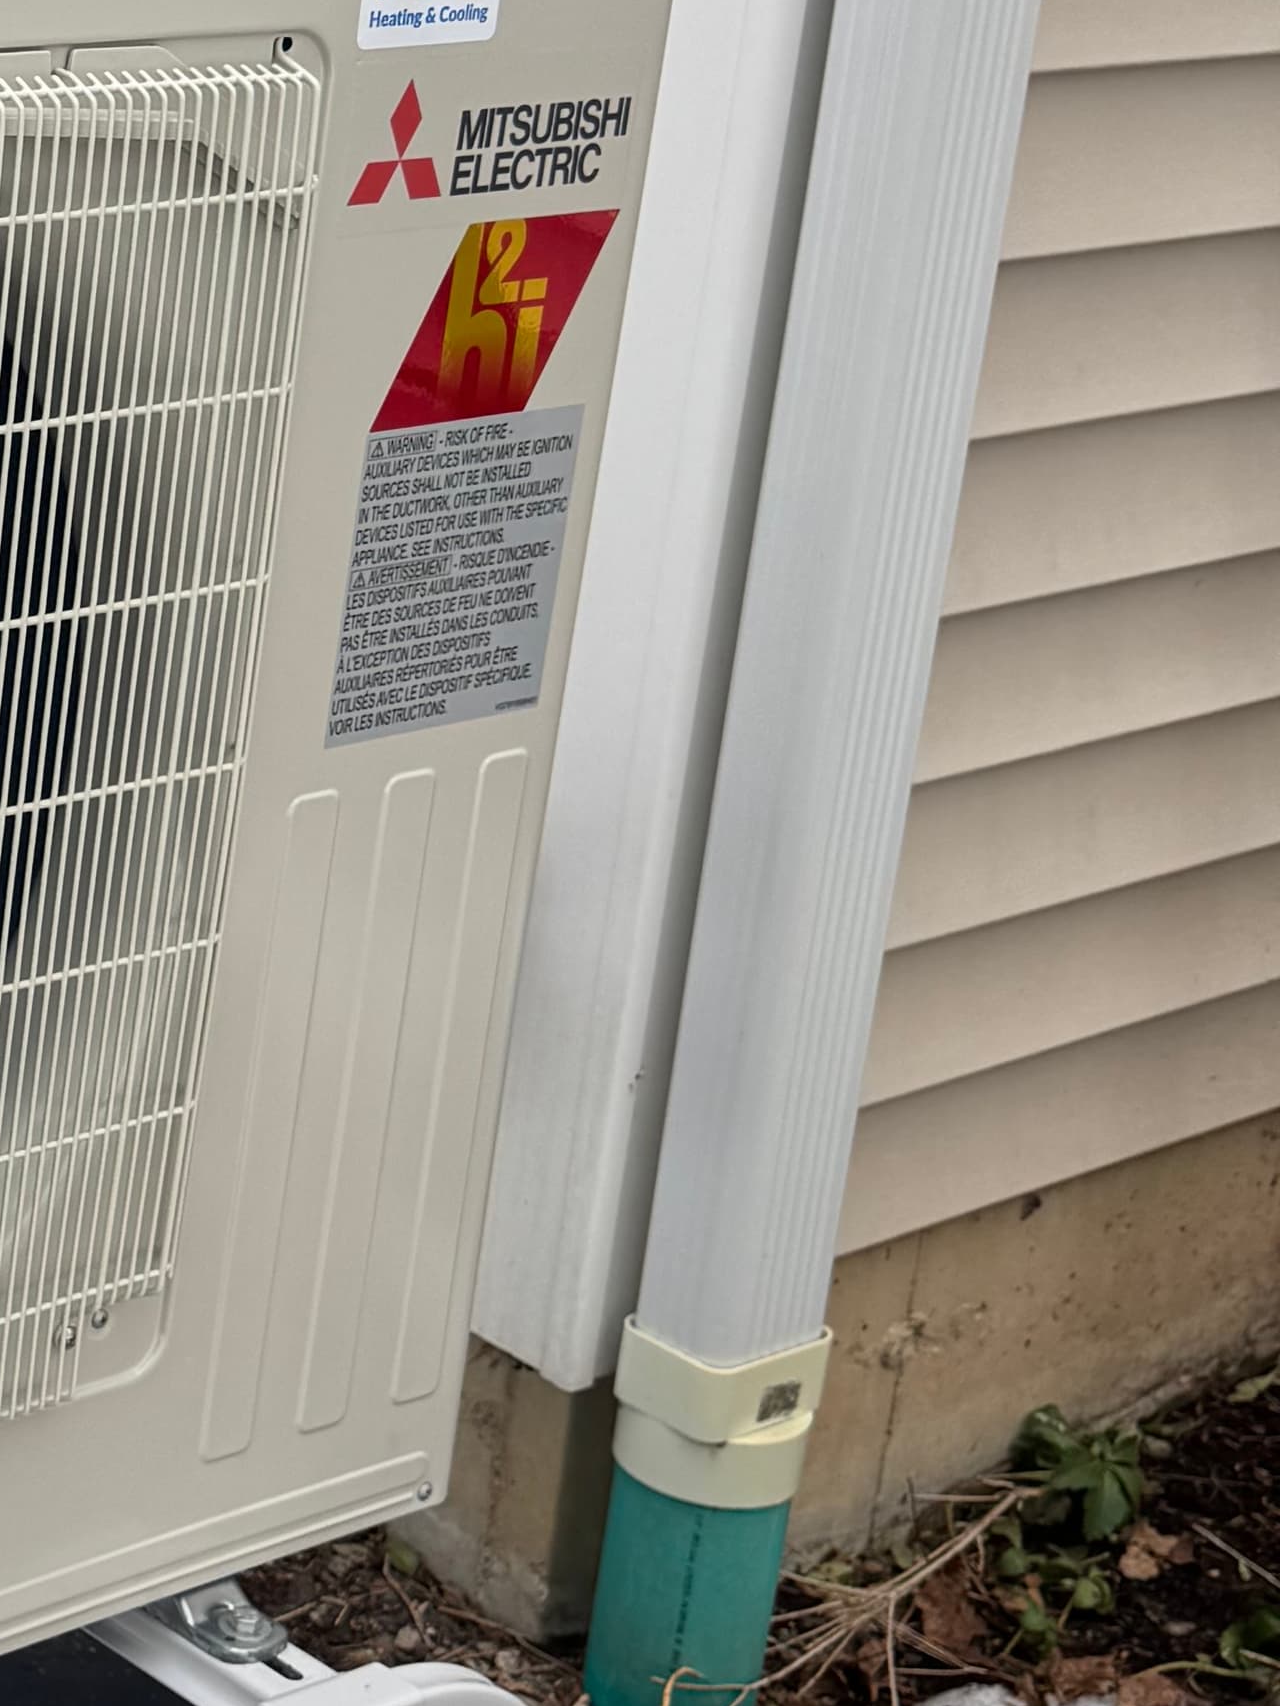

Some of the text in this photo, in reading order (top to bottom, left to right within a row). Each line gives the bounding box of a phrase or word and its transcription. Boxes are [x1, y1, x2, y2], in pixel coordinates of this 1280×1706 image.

[368, 3, 489, 30] Heating & Cooling
[455, 96, 632, 152] MITSUBISHI
[448, 143, 603, 197] ELECTRIC
[364, 434, 574, 481] AUXILIARY DEVICES WHICH MAY BE IGNITION
[387, 434, 434, 454] WARNING
[445, 429, 469, 447] RISK
[470, 426, 485, 443] OF
[485, 423, 509, 442] FIRE
[358, 507, 370, 524] IN
[372, 503, 391, 522] THE
[453, 488, 487, 509] OTHER
[489, 484, 515, 503] THAN
[515, 477, 564, 500] AUXILIARY
[361, 461, 532, 503] SOURCES SHALL NOT BE INSTALLED
[355, 496, 568, 546] DEVICES LISTED FOR USE WITH THE SPECIFIC
[368, 557, 449, 586] AVERTISSEMENT
[459, 549, 497, 570] RISQUE
[497, 540, 550, 564] D'INCENDIE
[411, 539, 432, 557] SEE
[346, 563, 533, 611] LES DISPOSITIFS AUXILIAIRES POUVANT
[371, 608, 392, 626] DES
[393, 599, 441, 623] SOURCES
[442, 596, 457, 614] DE
[458, 593, 478, 610] FEU
[478, 590, 493, 607] NE
[494, 583, 536, 605] DOIVENT
[340, 634, 360, 653] PAS
[441, 614, 468, 634] DANS
[469, 611, 489, 629] LES
[346, 646, 410, 673] L'EXCEPTION
[410, 642, 431, 660] DES
[432, 631, 491, 656] DISPOSITIFS
[334, 669, 394, 695] AUXILIAIRES
[464, 650, 492, 670] POUR
[376, 687, 404, 707] AVEC
[405, 684, 418, 702] LE
[418, 673, 473, 699] DISPOSITIF
[329, 717, 353, 737] VOIR
[354, 713, 373, 732] LES
